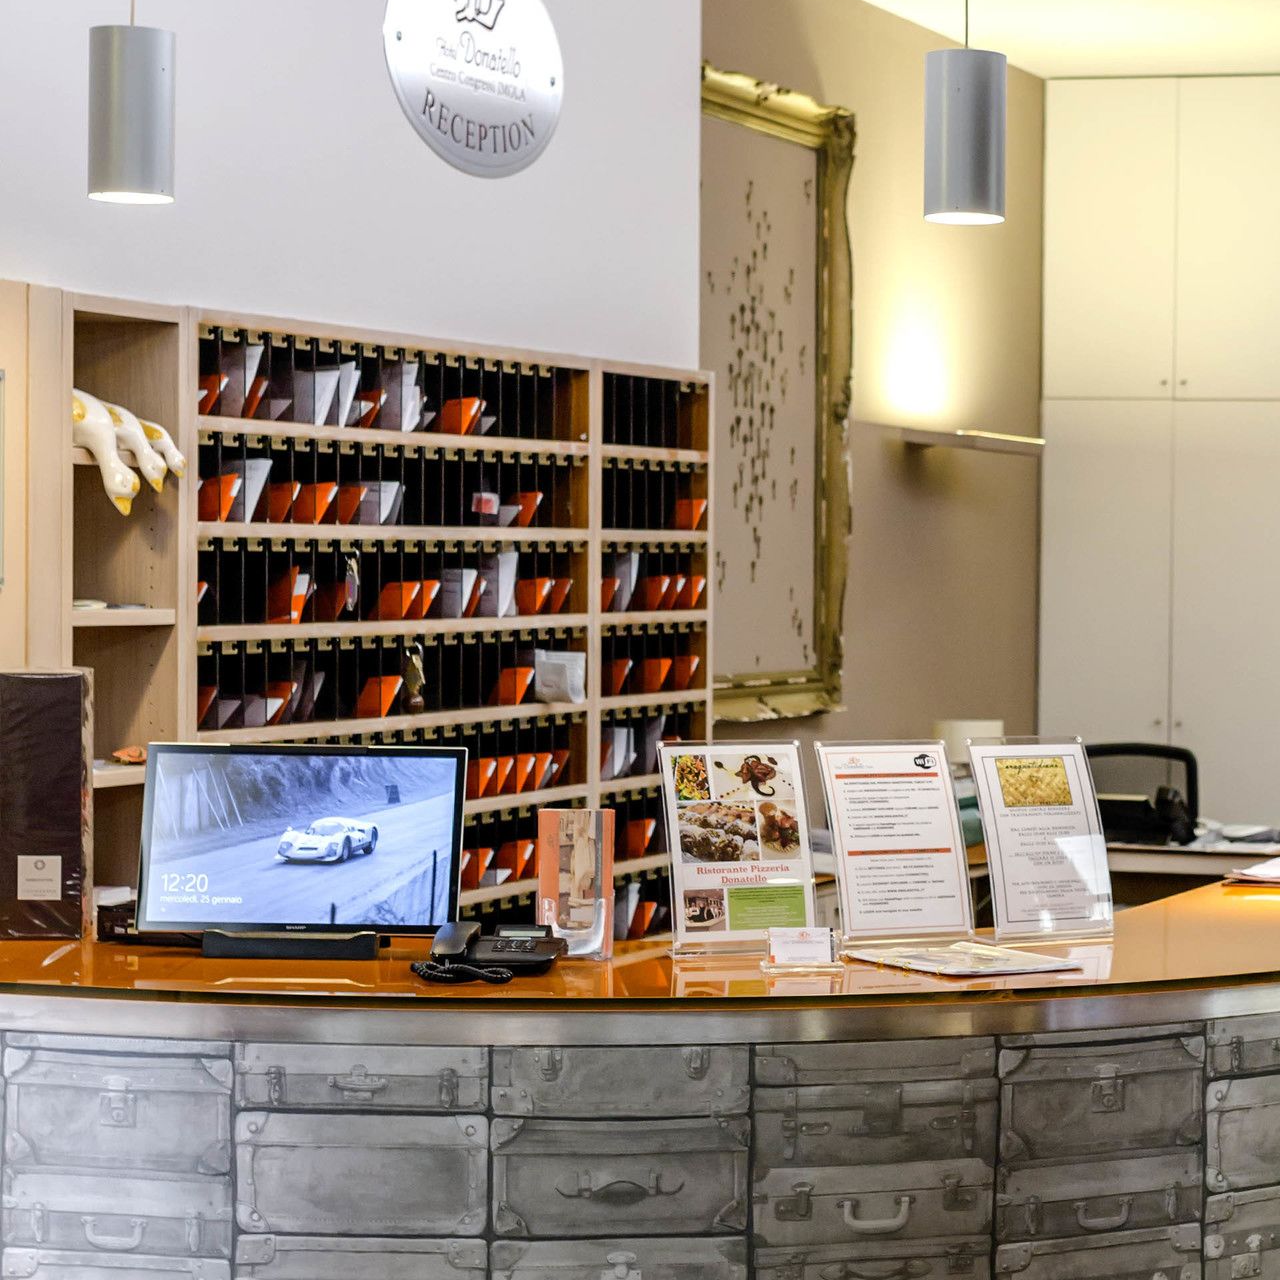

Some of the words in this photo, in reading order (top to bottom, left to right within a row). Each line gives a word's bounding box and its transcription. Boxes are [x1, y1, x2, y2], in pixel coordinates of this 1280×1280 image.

[459, 31, 521, 78] Donatello
[422, 88, 536, 153] RECEPTION
[696, 864, 749, 876] Ristorante
[750, 863, 790, 873] Pizzeria
[721, 874, 768, 885] Donatello
[160, 873, 209, 893] 12:20
